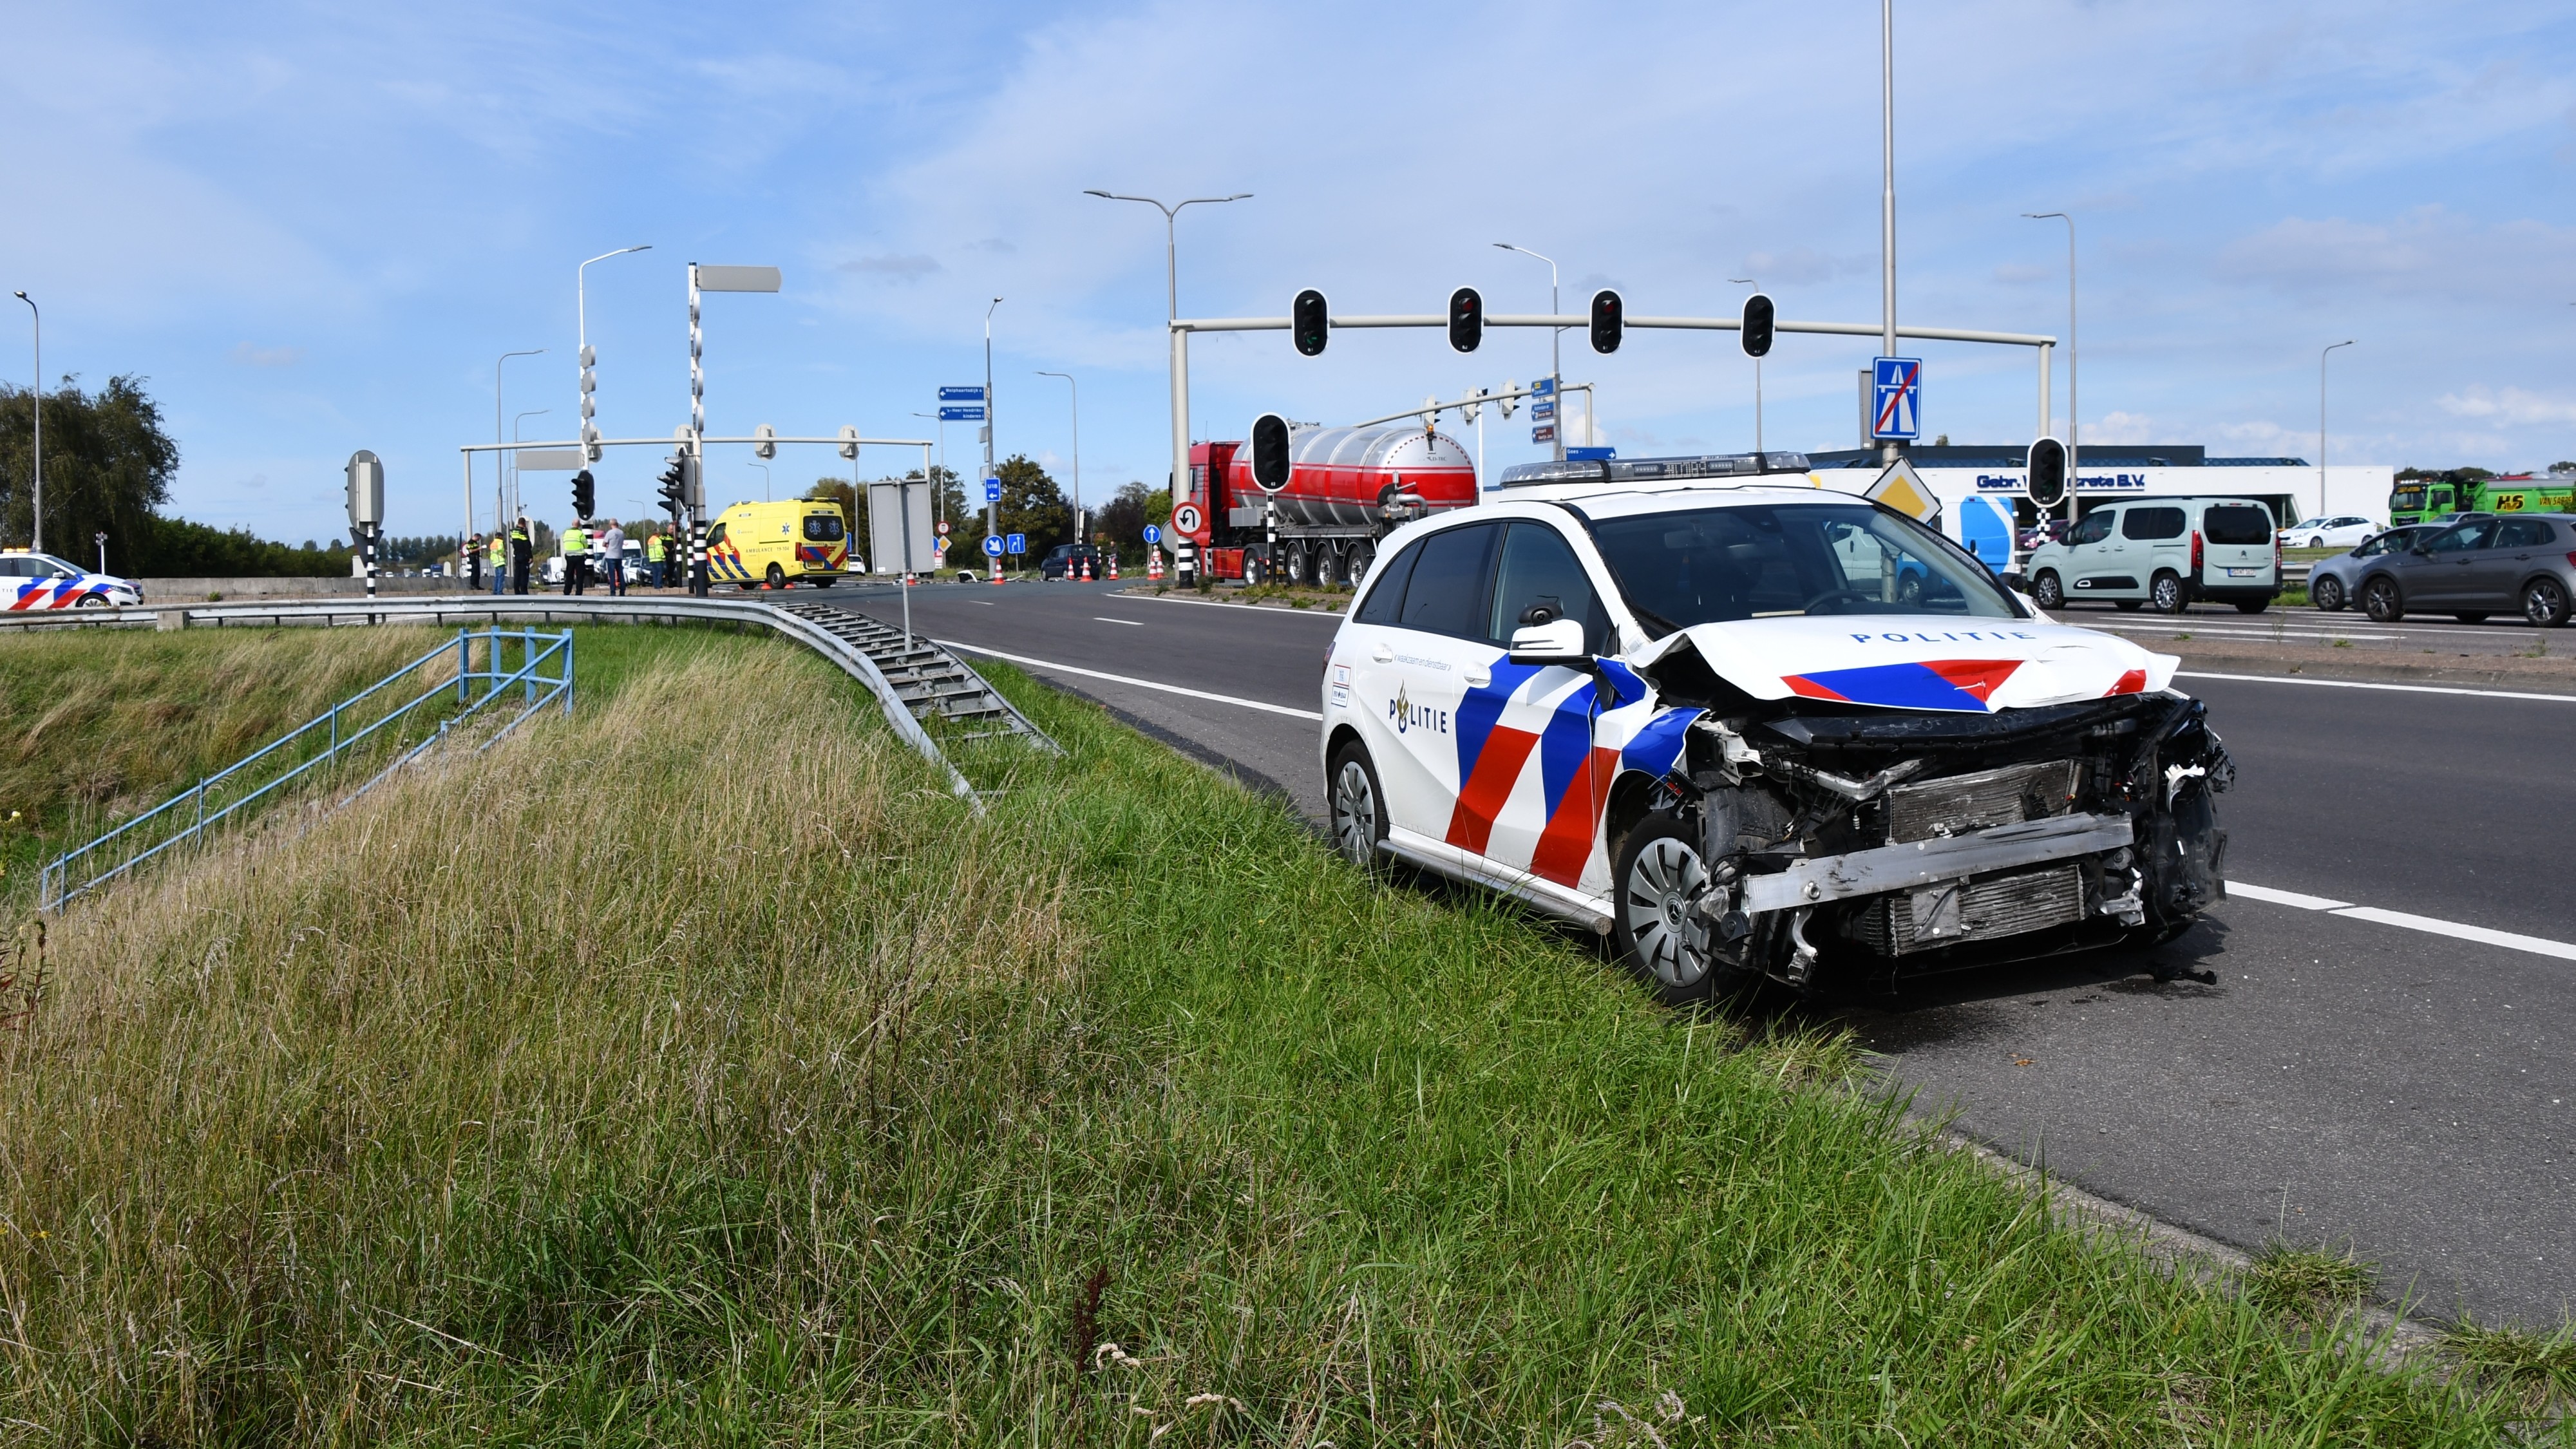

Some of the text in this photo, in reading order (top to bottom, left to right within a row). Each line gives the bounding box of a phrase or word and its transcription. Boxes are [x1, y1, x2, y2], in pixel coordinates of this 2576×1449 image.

[1976, 475, 2021, 488] Gebr.
[2117, 474, 2145, 487] B.V.
[2539, 497, 2552, 506] VAN
[1849, 632, 2037, 643] POLITIE
[1390, 698, 1446, 734] POLITIE
